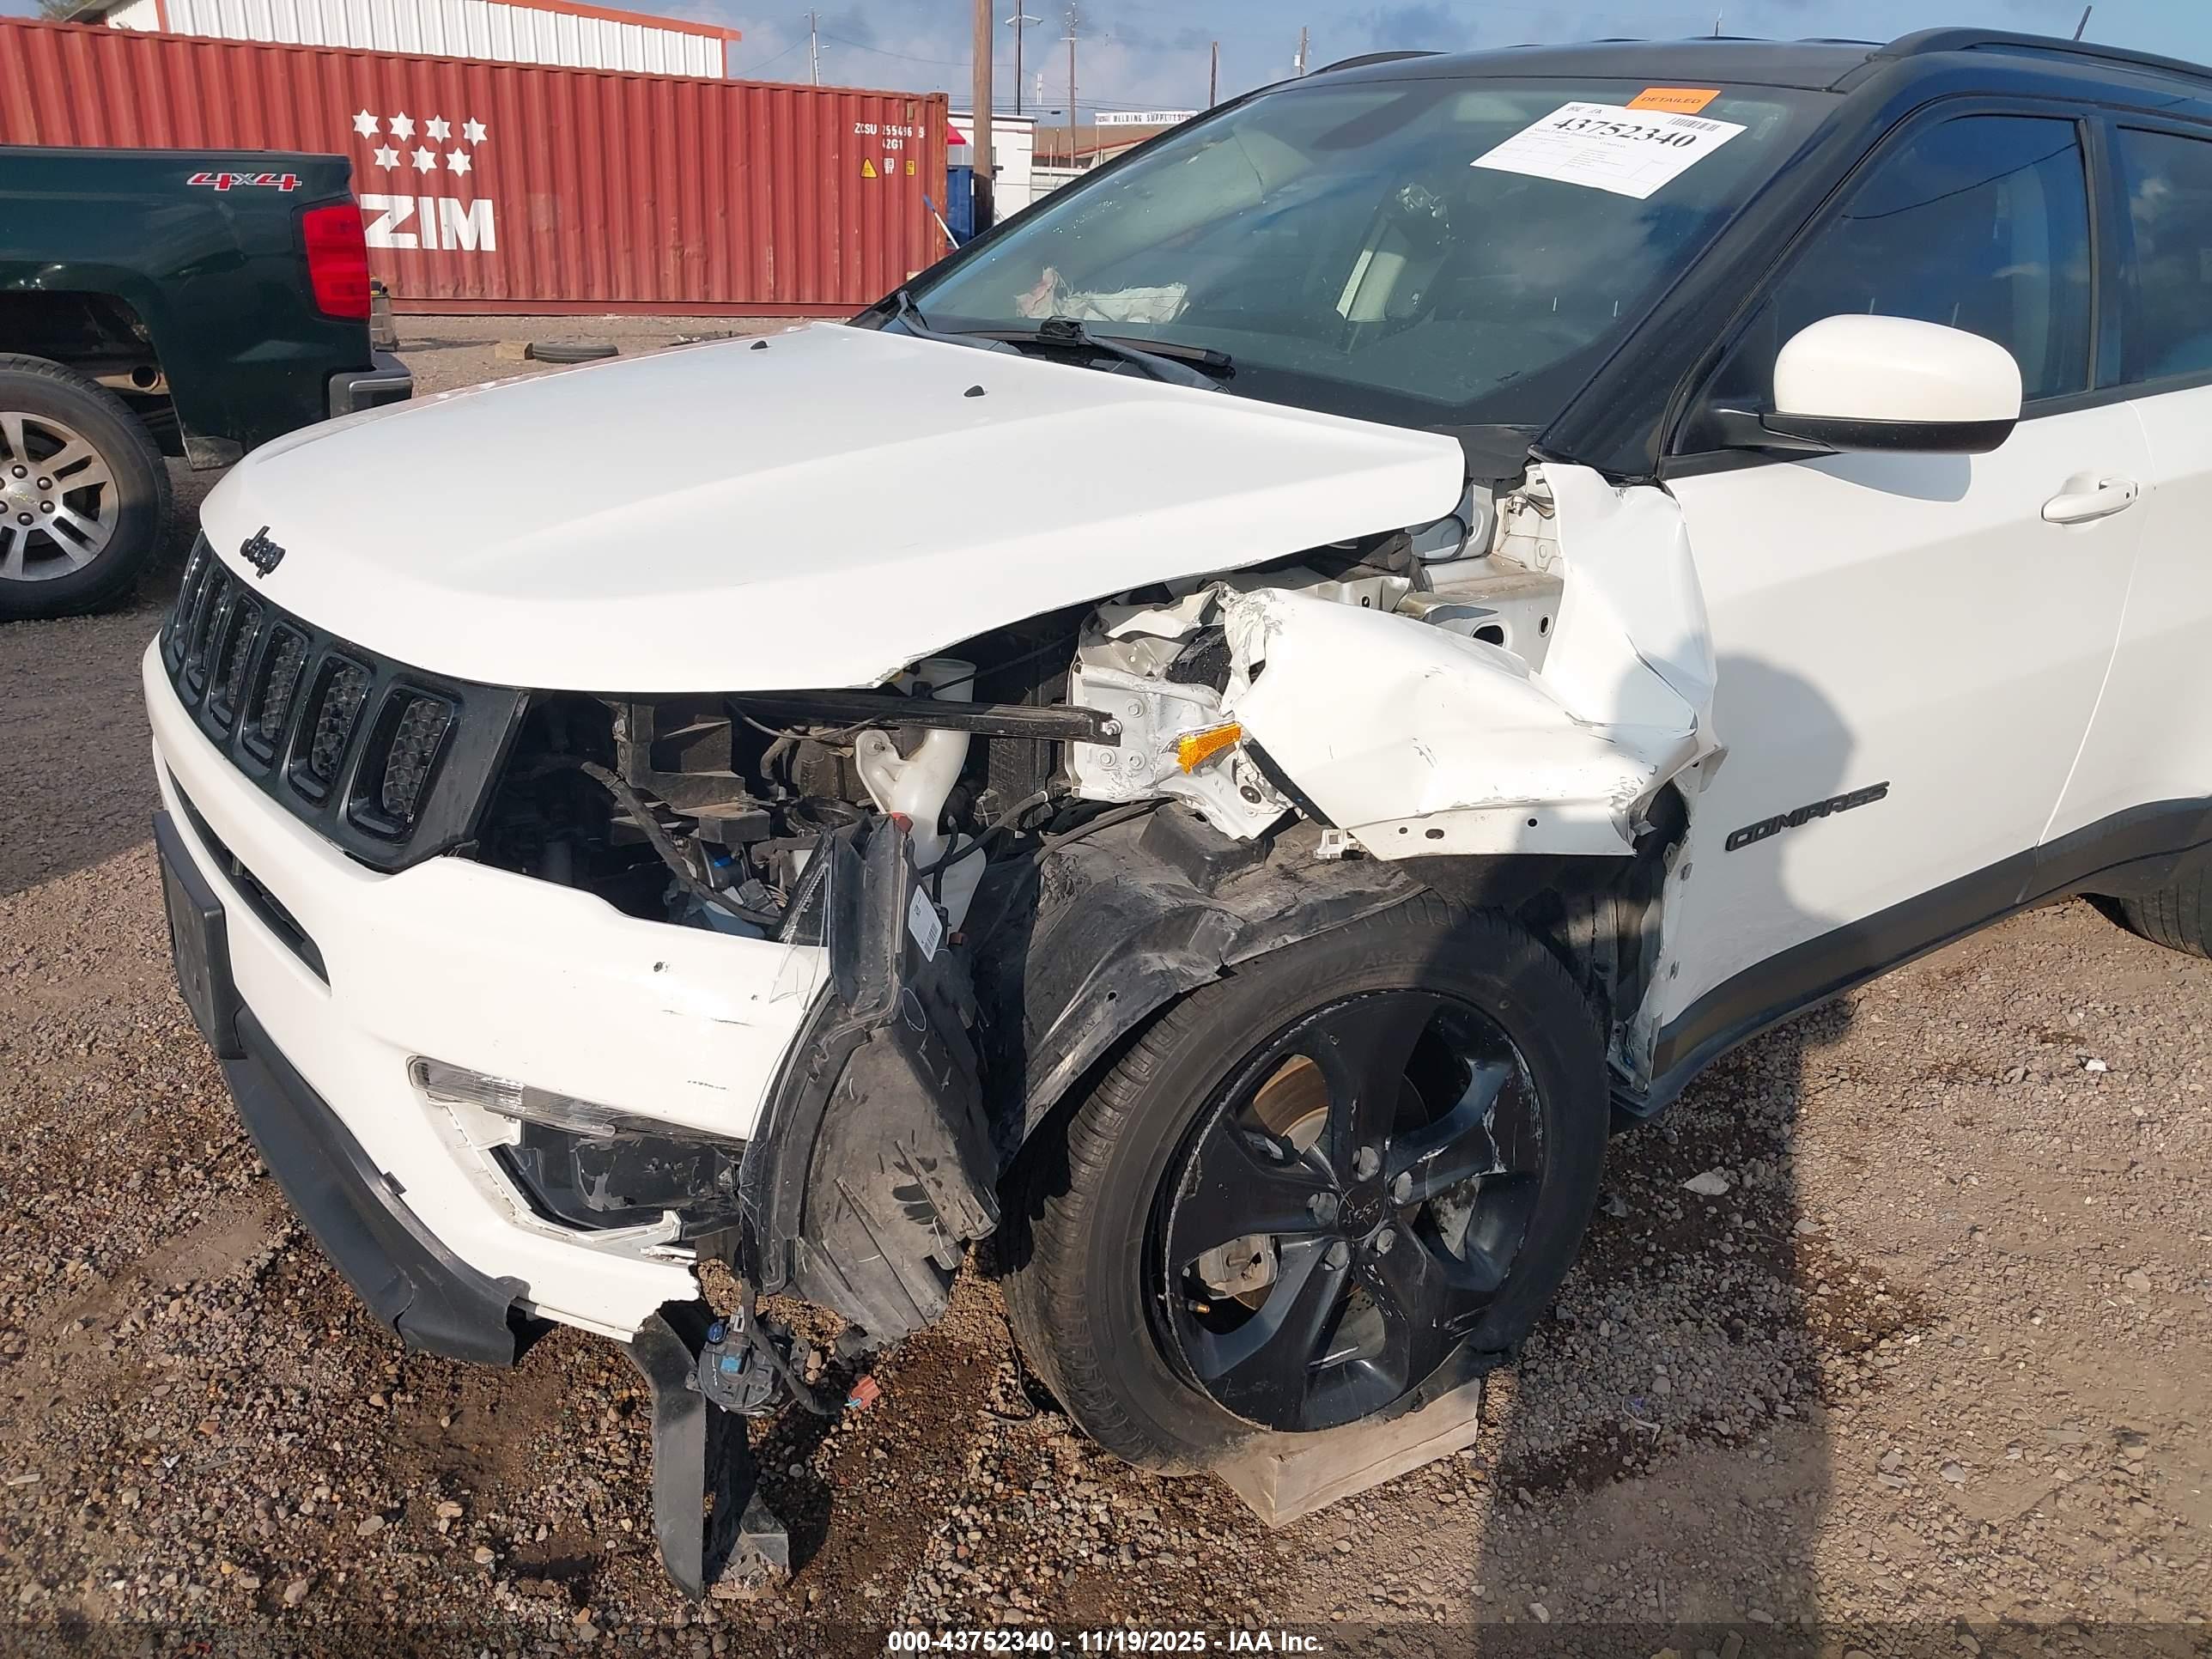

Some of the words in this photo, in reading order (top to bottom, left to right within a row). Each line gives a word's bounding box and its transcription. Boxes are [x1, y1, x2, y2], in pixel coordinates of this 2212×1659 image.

[854, 122, 878, 135] ZCSU
[1113, 114, 1142, 123] WELDING
[1553, 117, 1697, 148] 43752340
[359, 193, 496, 252] ZIM
[1725, 781, 1890, 852] COMPASS
